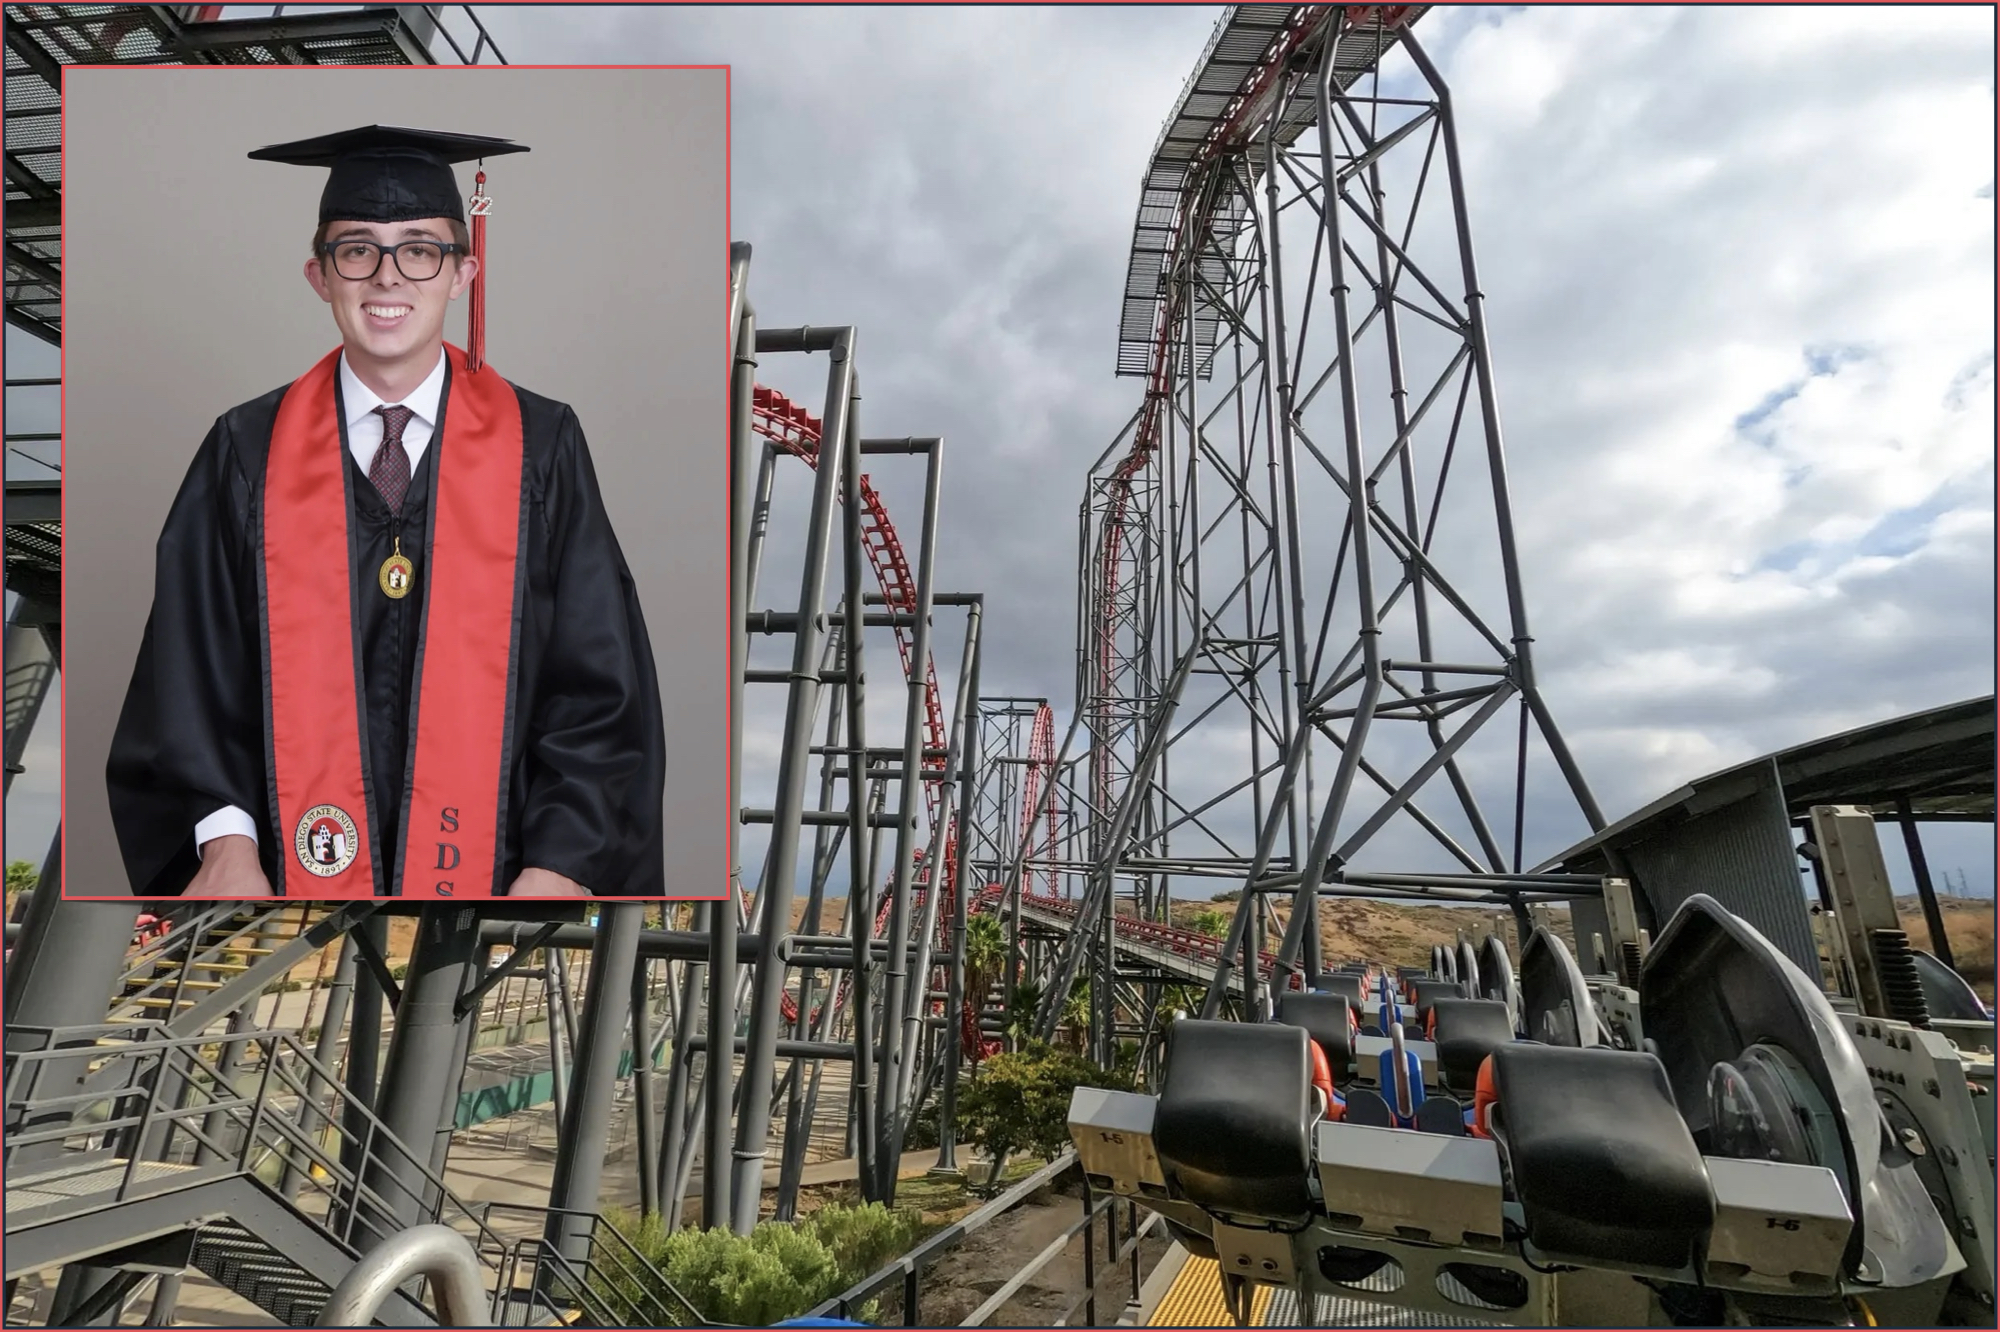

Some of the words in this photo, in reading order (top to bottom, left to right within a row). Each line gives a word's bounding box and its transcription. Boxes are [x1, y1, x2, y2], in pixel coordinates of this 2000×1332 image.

[307, 808, 331, 823] STATE
[299, 822, 309, 851] DIEGO
[334, 811, 356, 860] UNIVERSITY
[301, 852, 315, 868] SAN
[321, 864, 341, 875] 1897
[1100, 1132, 1124, 1145] 1-5
[1766, 1218, 1801, 1231] 1-6
